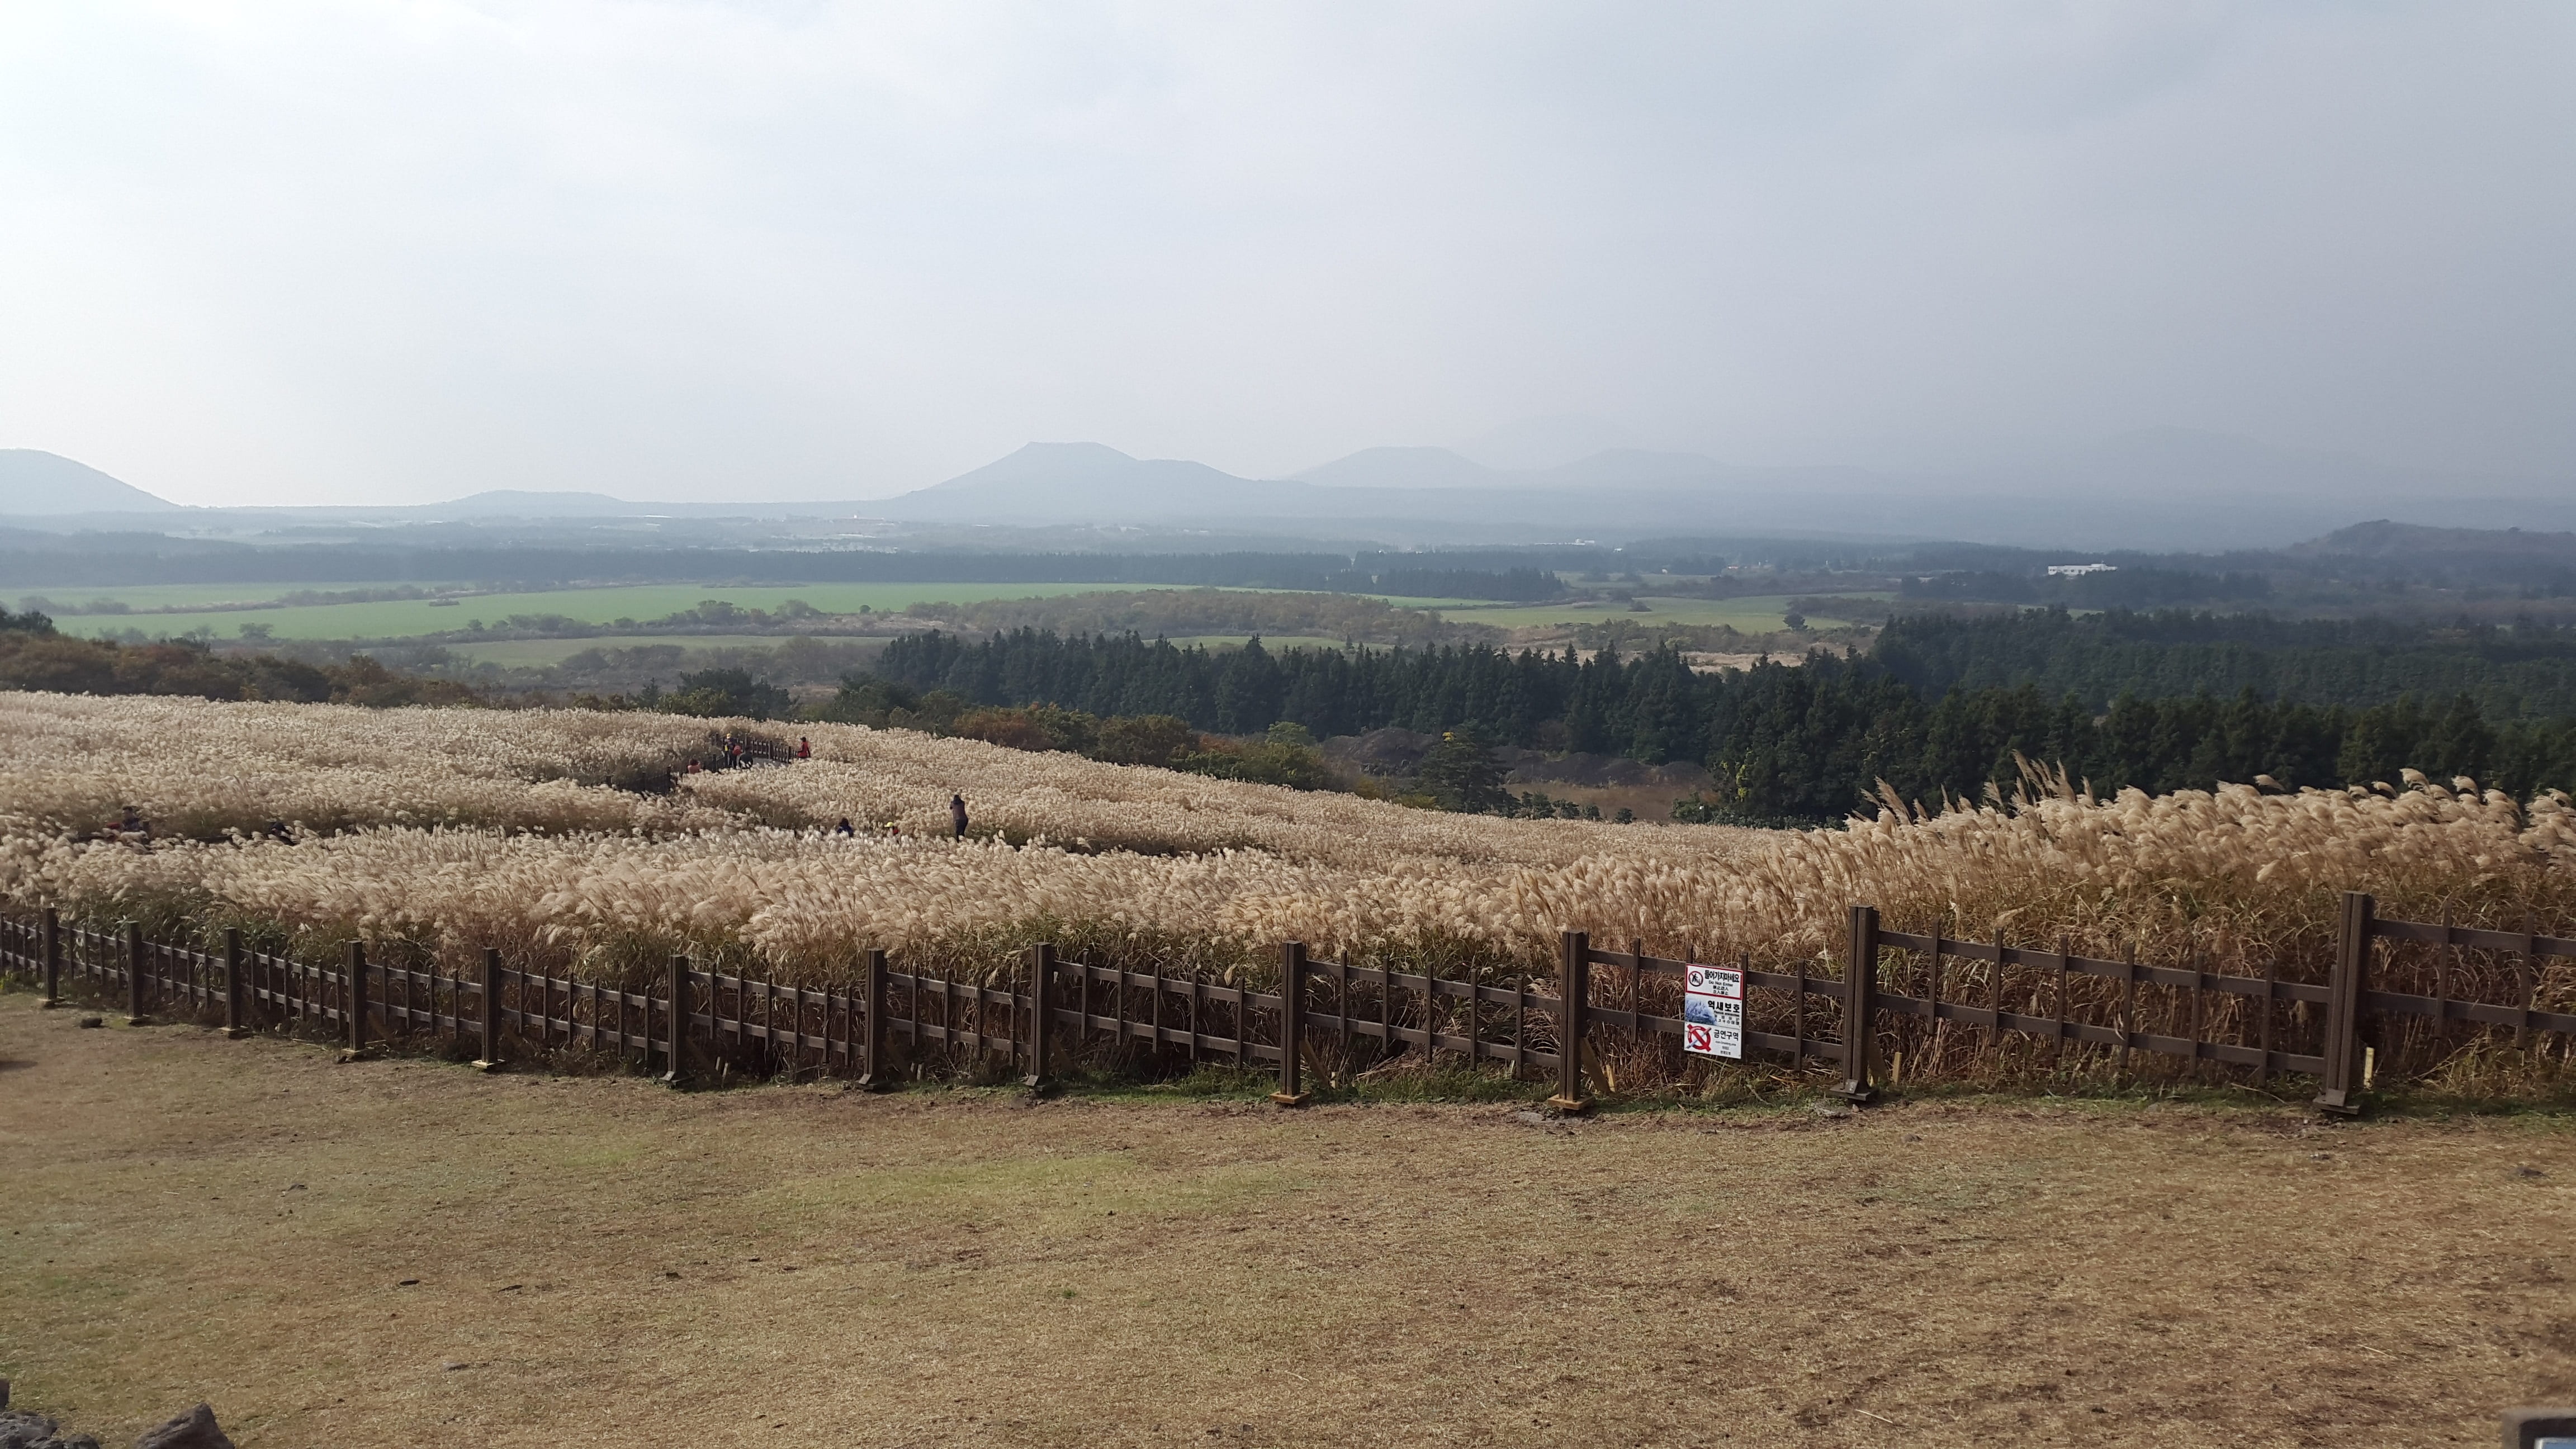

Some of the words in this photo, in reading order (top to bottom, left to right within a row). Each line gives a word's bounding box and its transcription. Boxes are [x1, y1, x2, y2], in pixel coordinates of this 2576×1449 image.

[1704, 970, 1739, 982] 들어가지마세요
[1708, 1001, 1740, 1013] 억새보호
[1714, 1030, 1738, 1041] 금연구역
